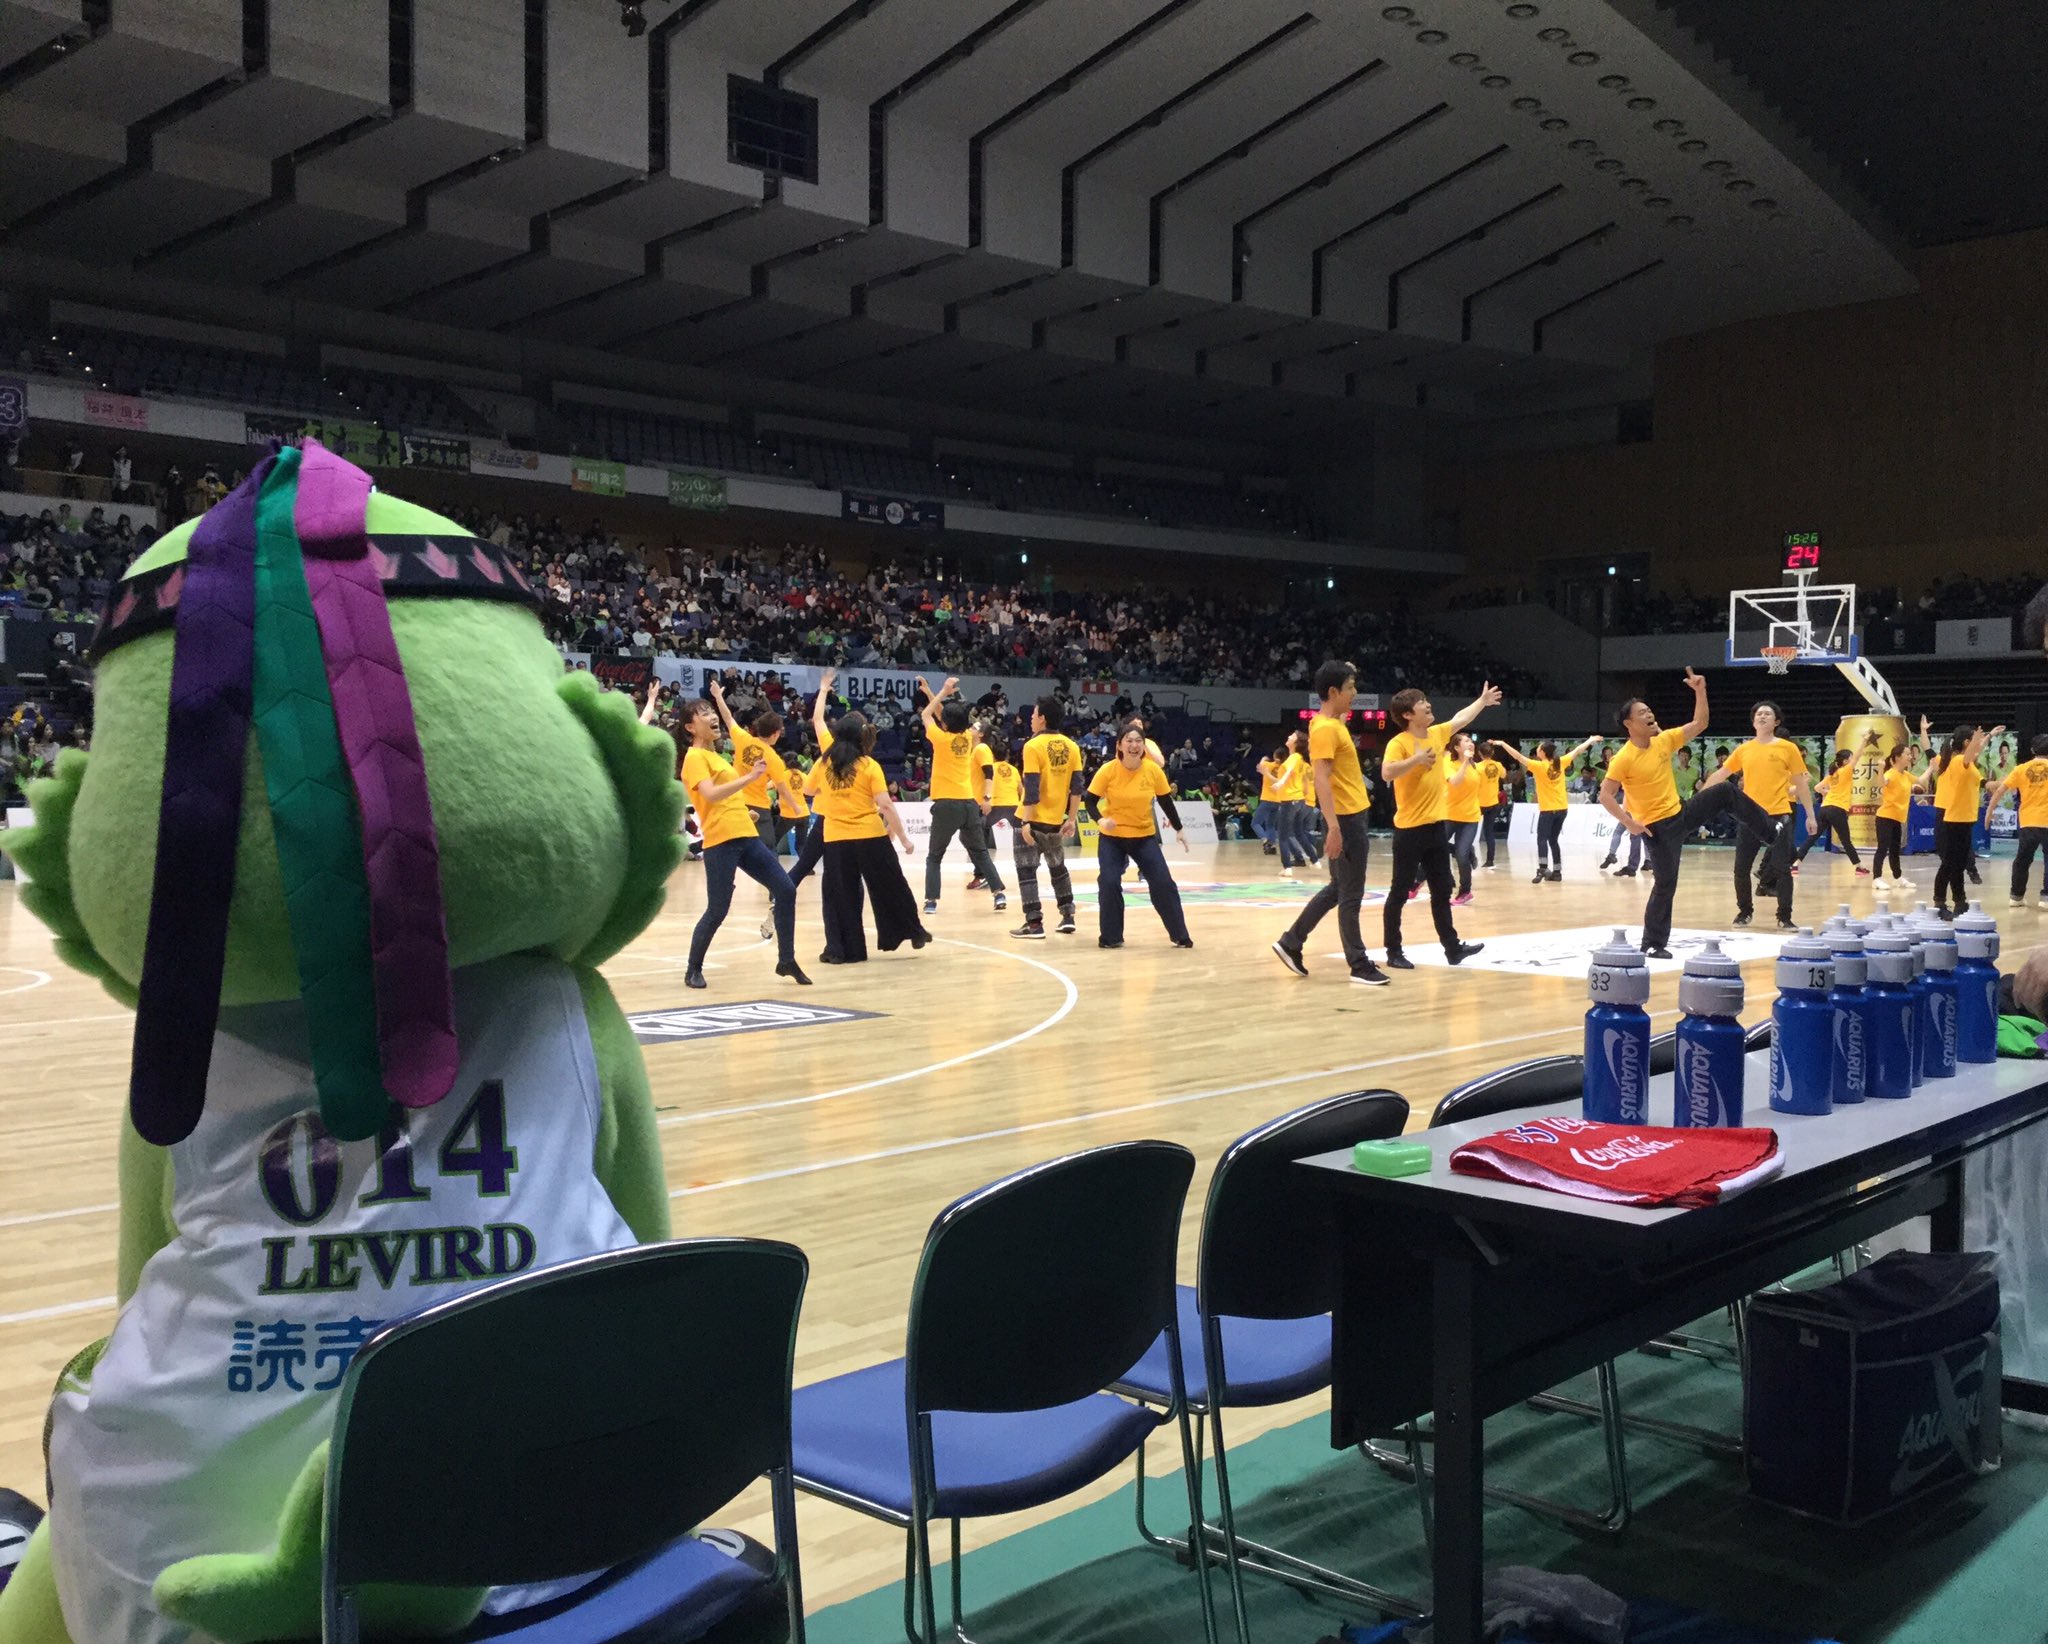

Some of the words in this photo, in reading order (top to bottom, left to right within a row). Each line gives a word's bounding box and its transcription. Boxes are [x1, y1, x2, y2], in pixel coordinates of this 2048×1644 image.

[1787, 546, 1820, 567] 24
[1788, 532, 1819, 545] 15:26
[1591, 971, 1611, 992] 33
[1808, 967, 1826, 988] 13
[1846, 1009, 1866, 1092] AQUARIUS
[1943, 993, 1957, 1068] AQUARIUS
[1620, 1029, 1641, 1121] AQUARIUS
[258, 1078, 519, 1227] 014
[1569, 1133, 1675, 1170] Coca-Cola
[257, 1221, 537, 1296] LEVIRD
